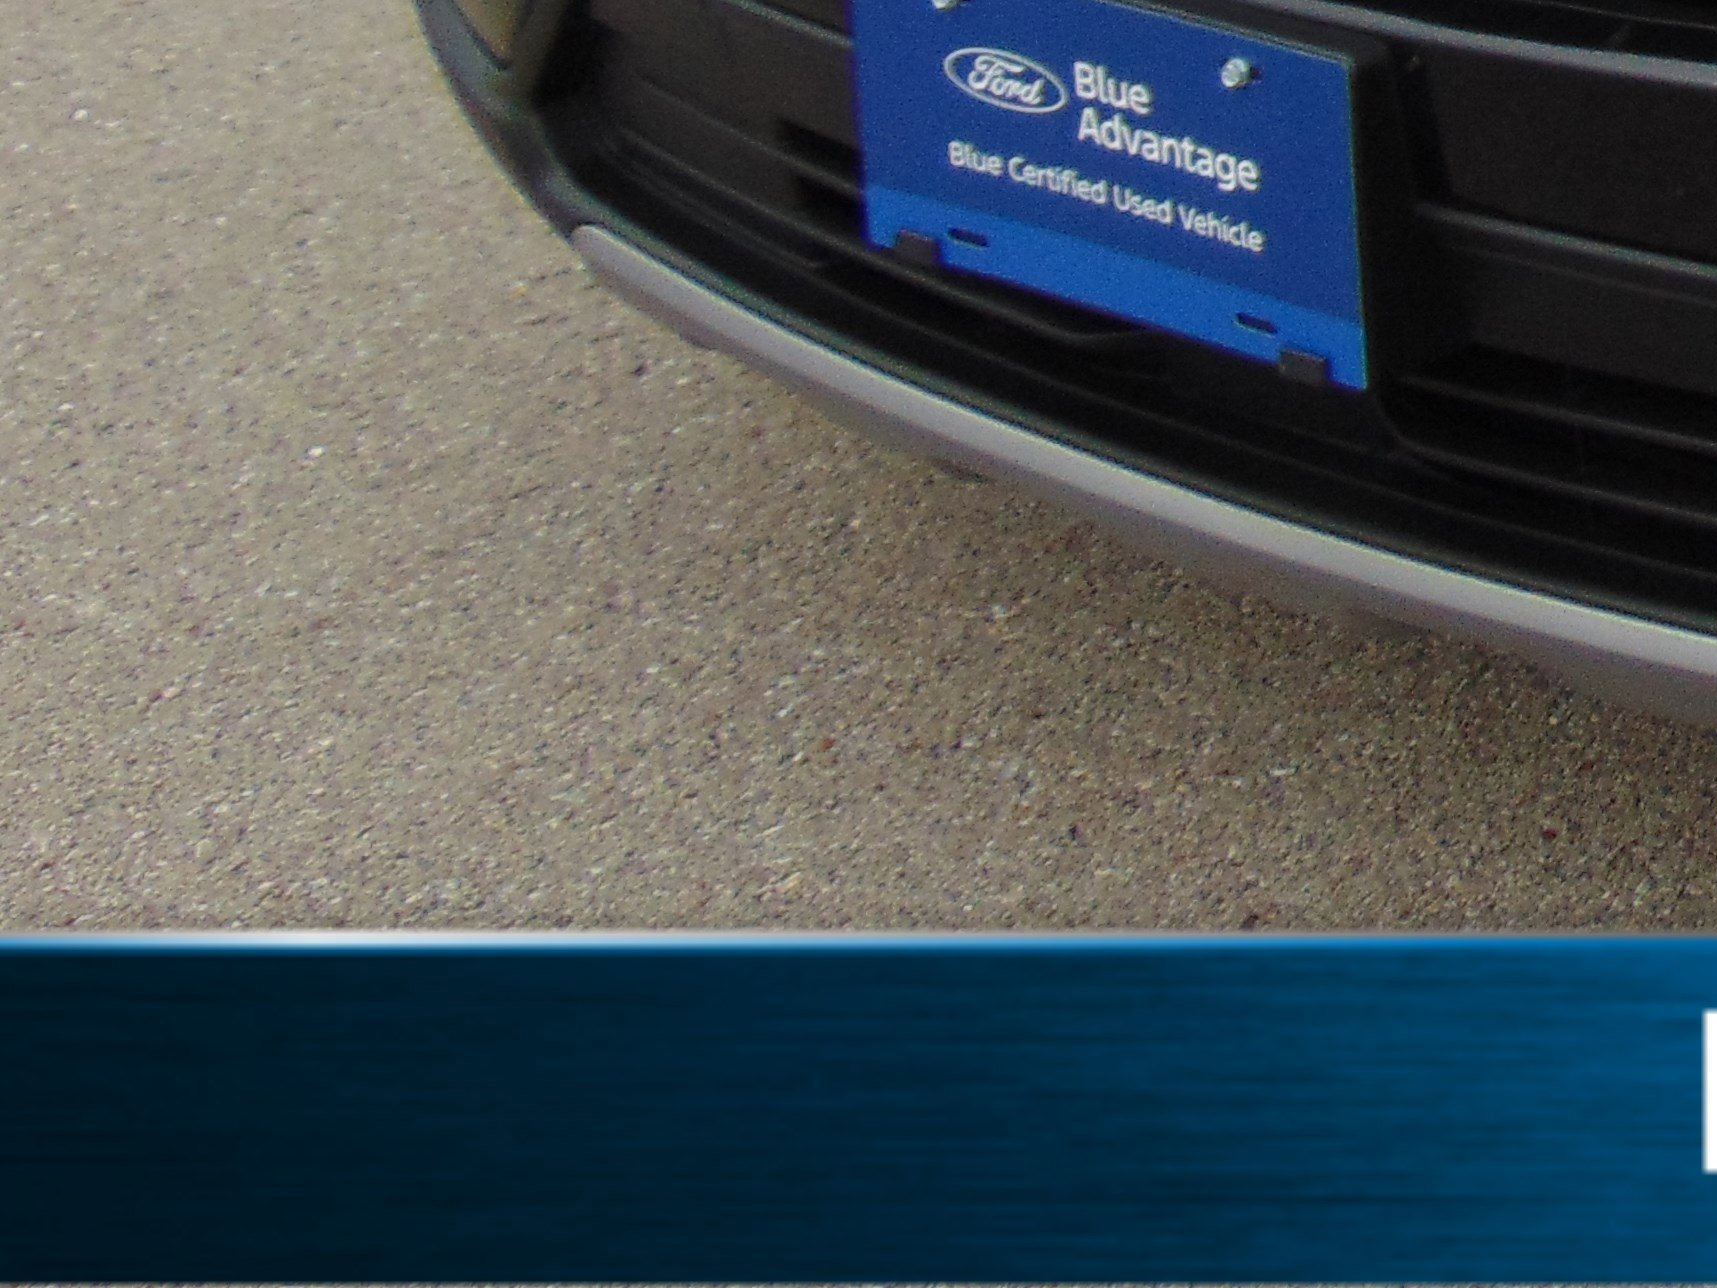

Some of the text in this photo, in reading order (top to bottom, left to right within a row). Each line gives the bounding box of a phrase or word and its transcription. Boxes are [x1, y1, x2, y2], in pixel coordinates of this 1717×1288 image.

[967, 54, 1046, 106] Ford
[1073, 60, 1152, 115] Blue
[1078, 106, 1260, 192] Advantage
[948, 140, 1266, 253] Blue Certified Used Vehicle
